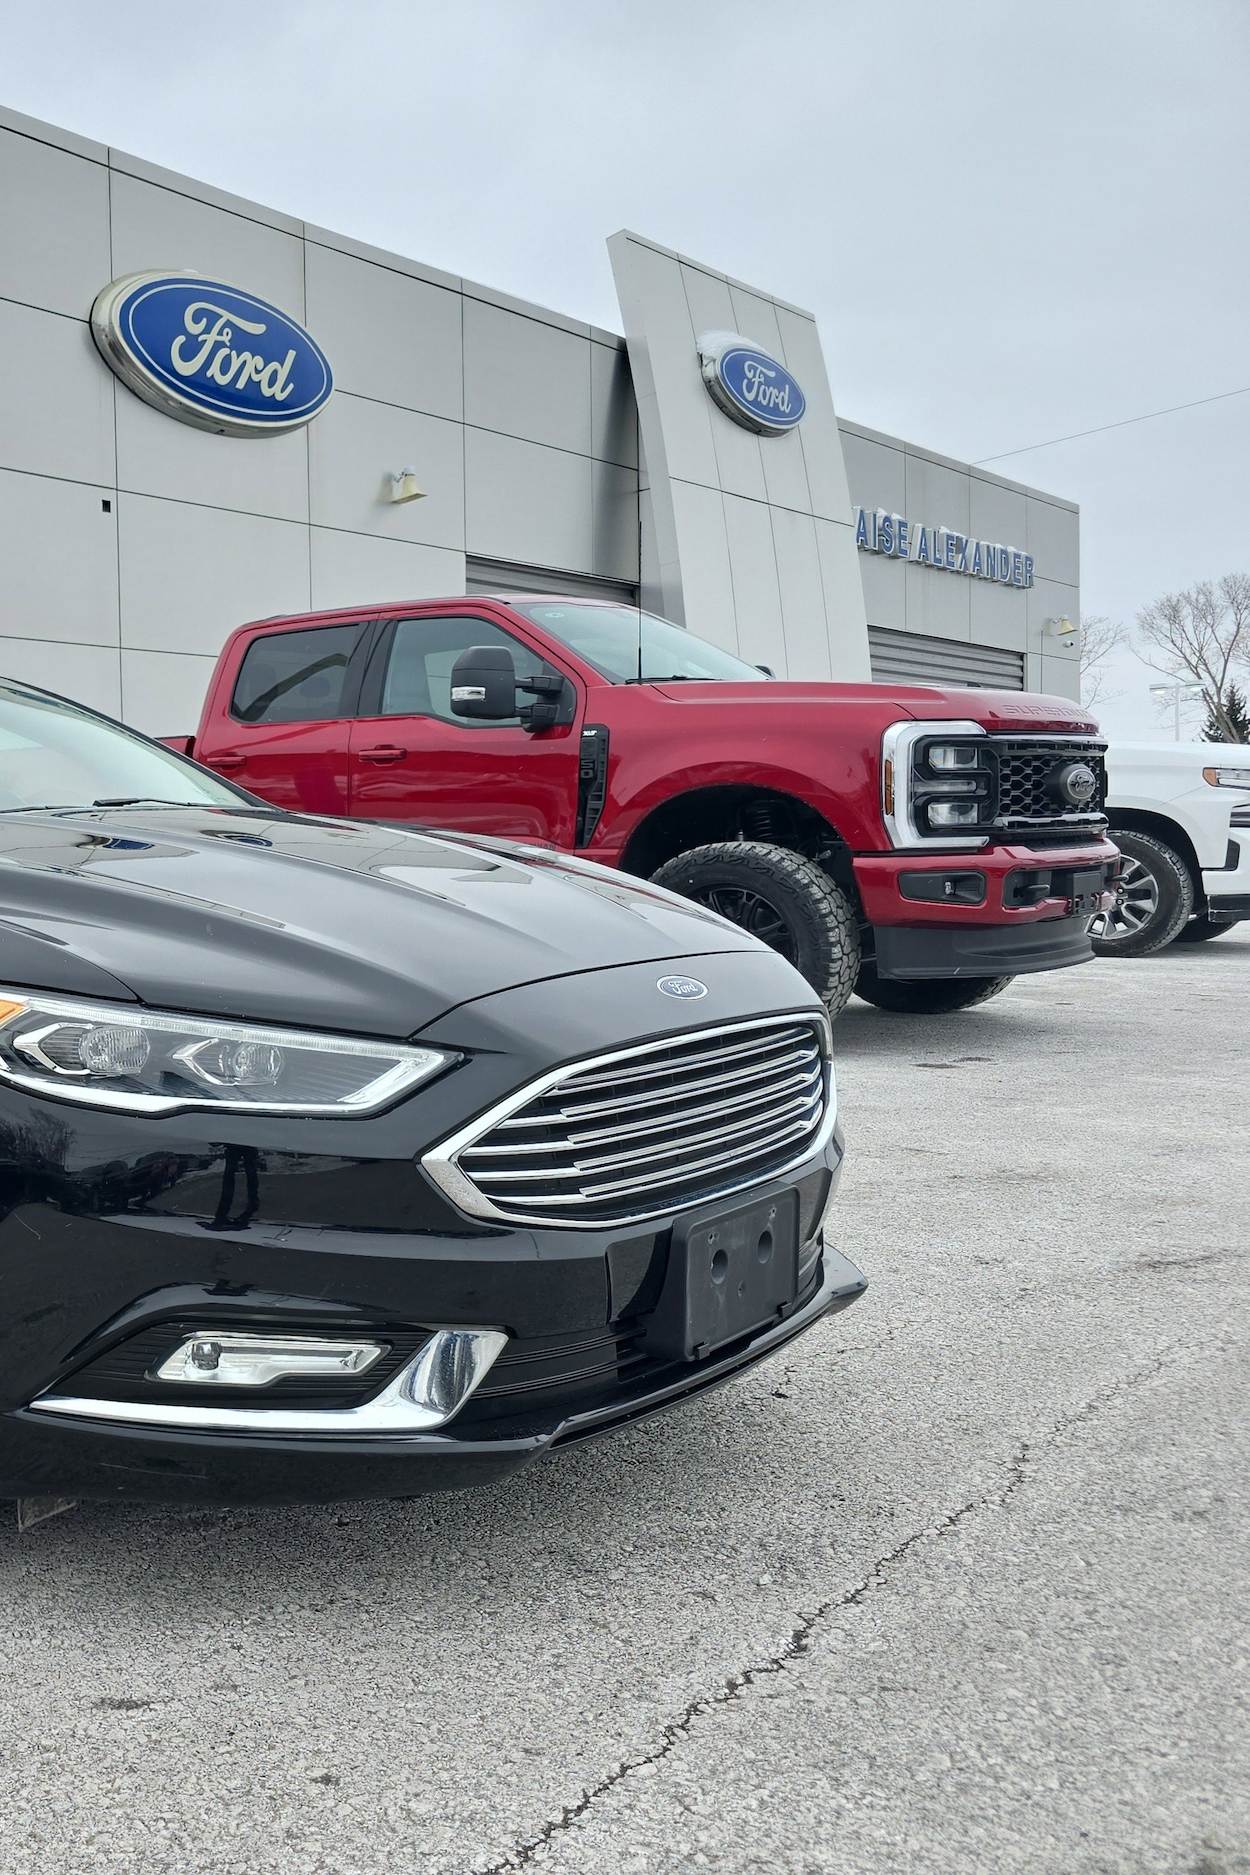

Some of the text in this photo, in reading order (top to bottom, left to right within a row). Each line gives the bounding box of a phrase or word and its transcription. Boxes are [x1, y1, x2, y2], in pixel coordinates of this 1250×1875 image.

[171, 302, 297, 401] Ford
[742, 360, 792, 413] Ford
[914, 524, 1035, 588] ALEXANDER
[668, 980, 698, 995] Ford
